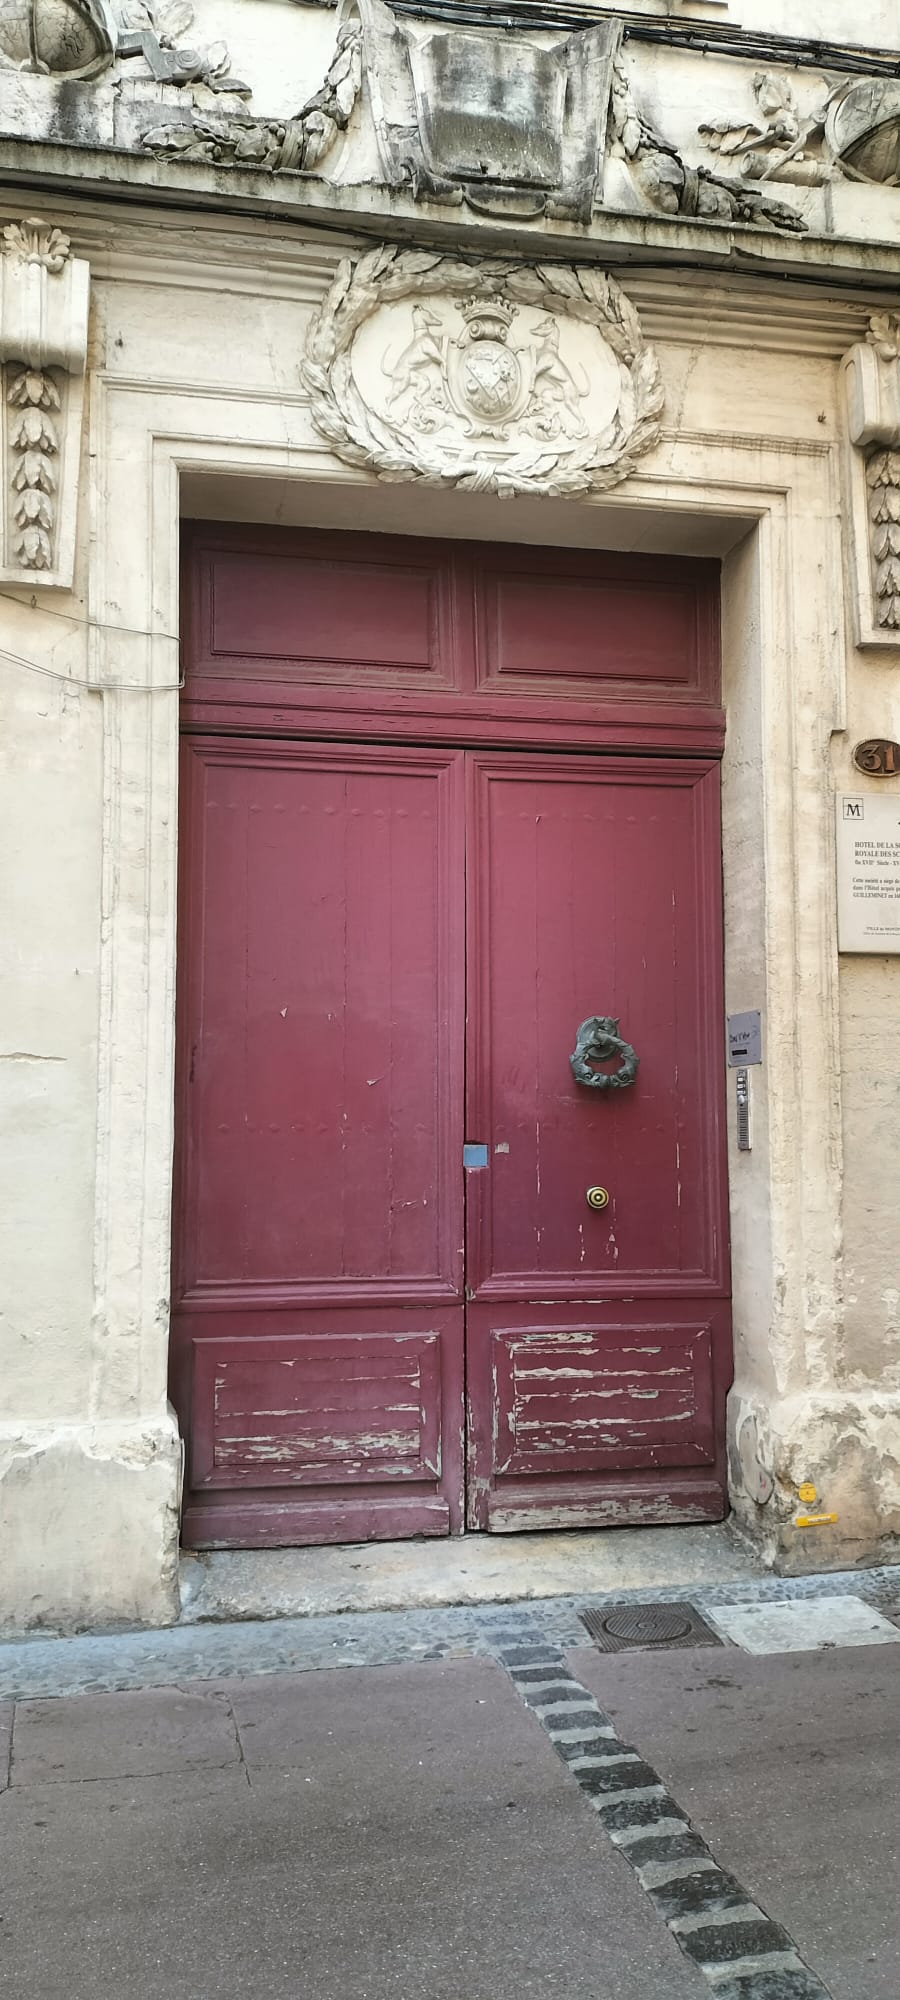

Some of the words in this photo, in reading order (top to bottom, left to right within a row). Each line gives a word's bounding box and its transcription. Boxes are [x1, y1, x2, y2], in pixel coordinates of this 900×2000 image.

[861, 744, 896, 771] 31
[846, 803, 861, 817] M
[854, 841, 876, 849] HOTEL
[876, 841, 886, 849] DE
[854, 850, 878, 858] ROYALE
[880, 850, 892, 858] DES
